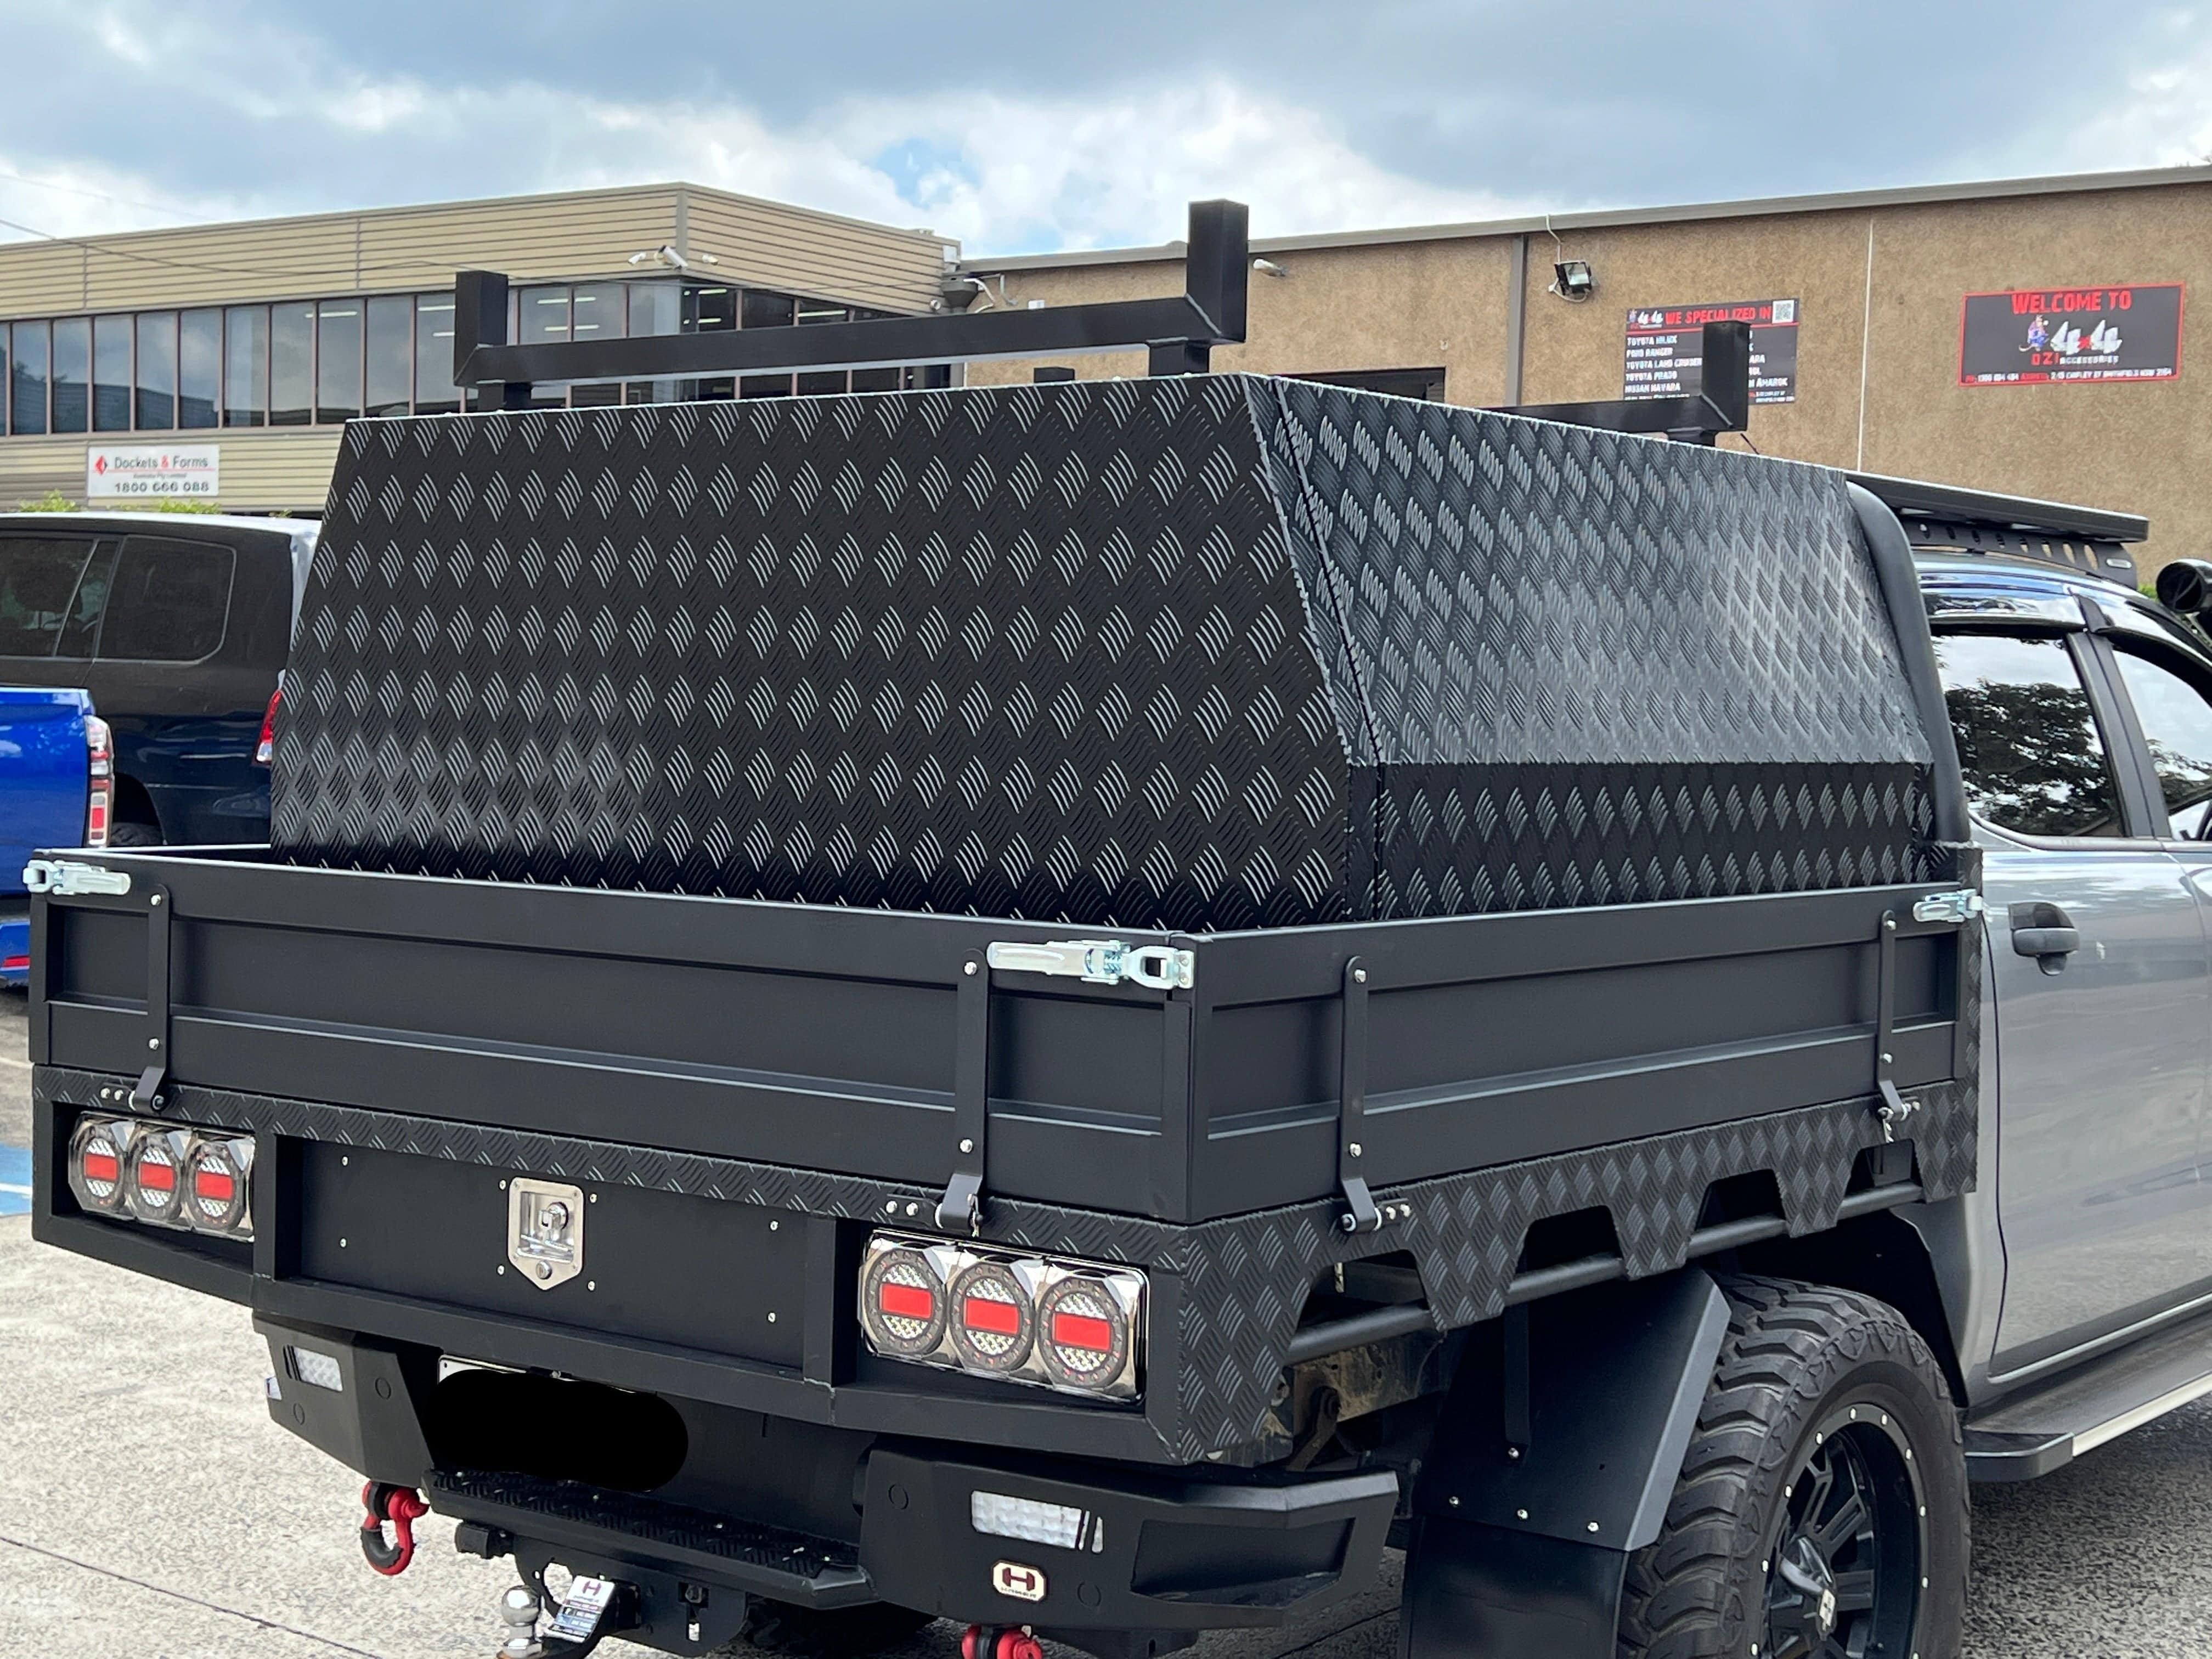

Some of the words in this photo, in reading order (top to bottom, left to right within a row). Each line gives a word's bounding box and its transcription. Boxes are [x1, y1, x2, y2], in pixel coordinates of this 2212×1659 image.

[2012, 291, 2102, 314] WELCOME
[2108, 290, 2133, 311] TO
[1665, 311, 1682, 325] WE
[1759, 306, 1772, 320] IN
[1627, 336, 1655, 347] TOYOTA
[1627, 348, 1644, 358] FORD
[1626, 359, 1654, 370] TOYOTA
[1626, 371, 1653, 382] TOYOTA
[115, 456, 158, 469] Dockets
[161, 455, 168, 467] &
[173, 455, 208, 467] Forms
[115, 482, 147, 493] 1800
[153, 481, 178, 492] 666
[183, 481, 209, 492] 088
